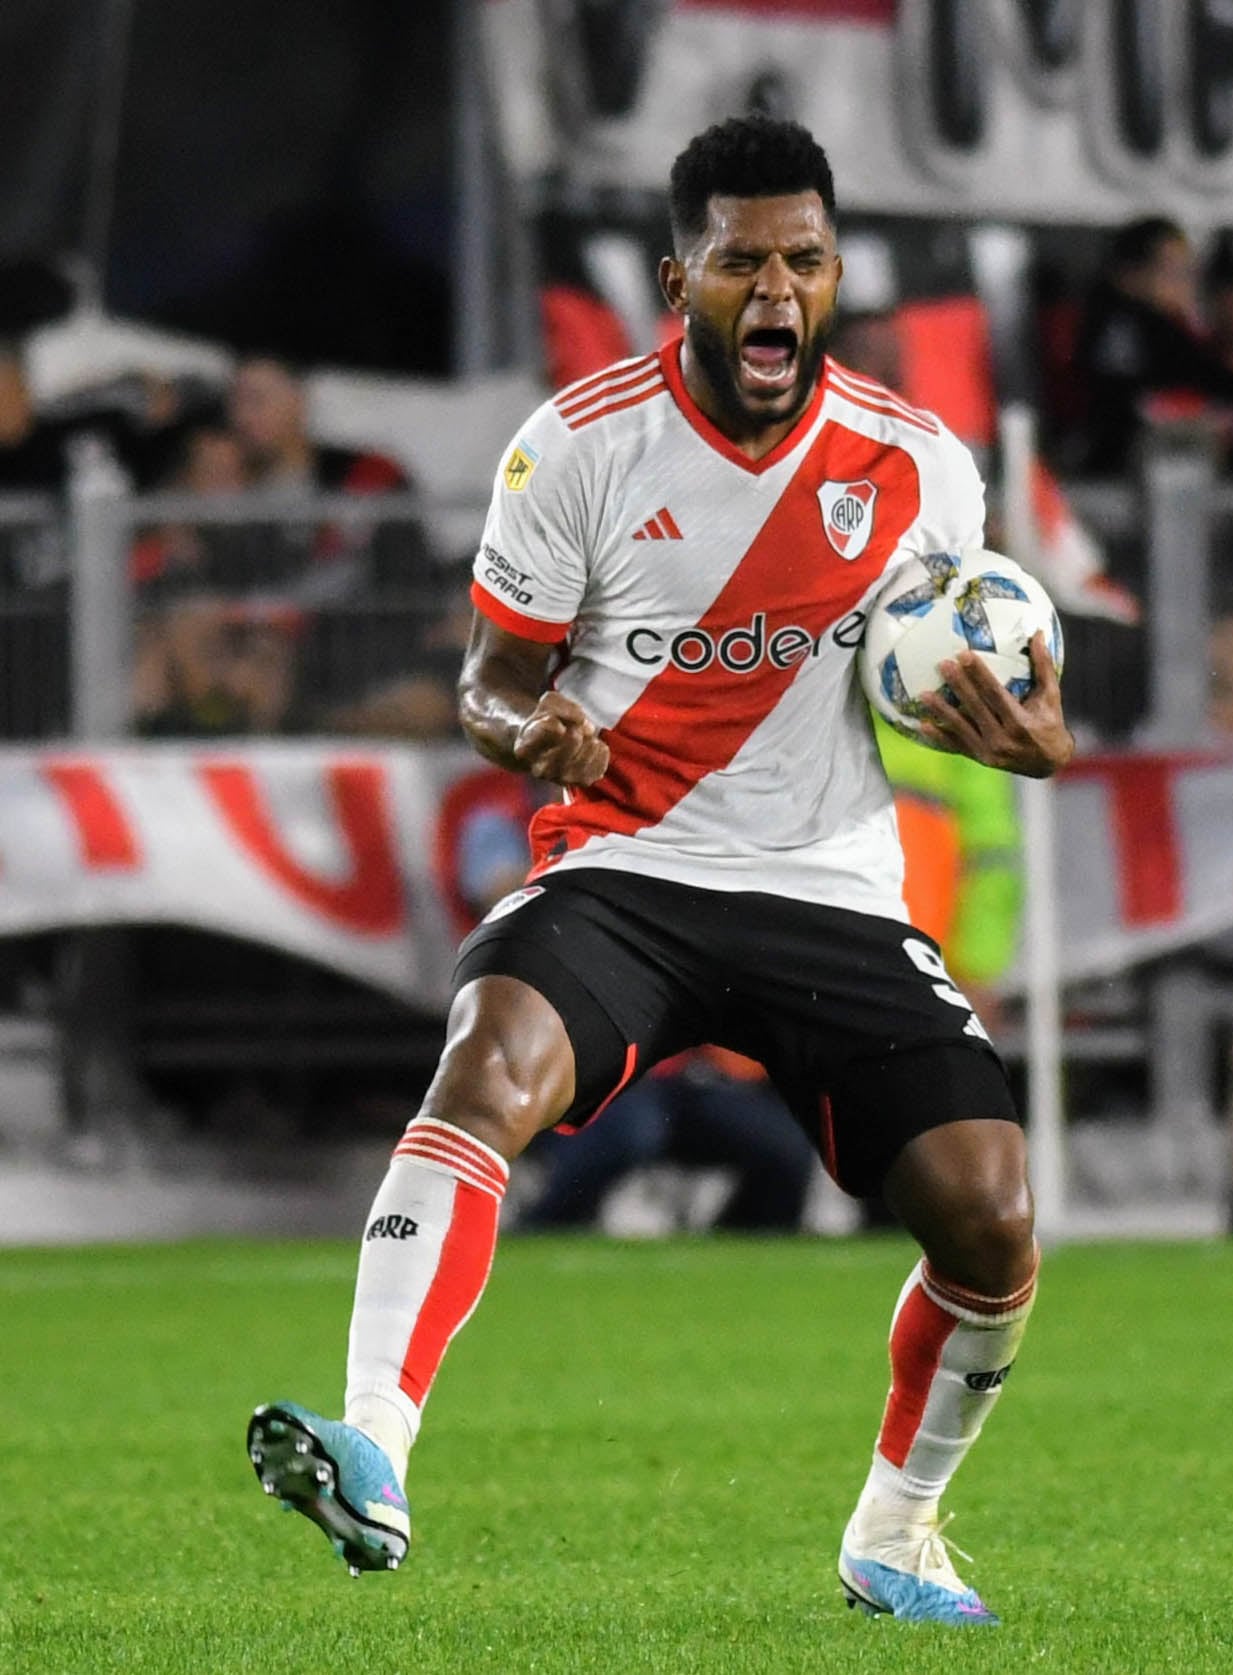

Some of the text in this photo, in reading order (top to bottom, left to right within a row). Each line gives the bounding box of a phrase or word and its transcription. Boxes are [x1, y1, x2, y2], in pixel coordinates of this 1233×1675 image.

[831, 496, 864, 532] CARP
[484, 567, 533, 606] CARD
[625, 611, 866, 674] codere
